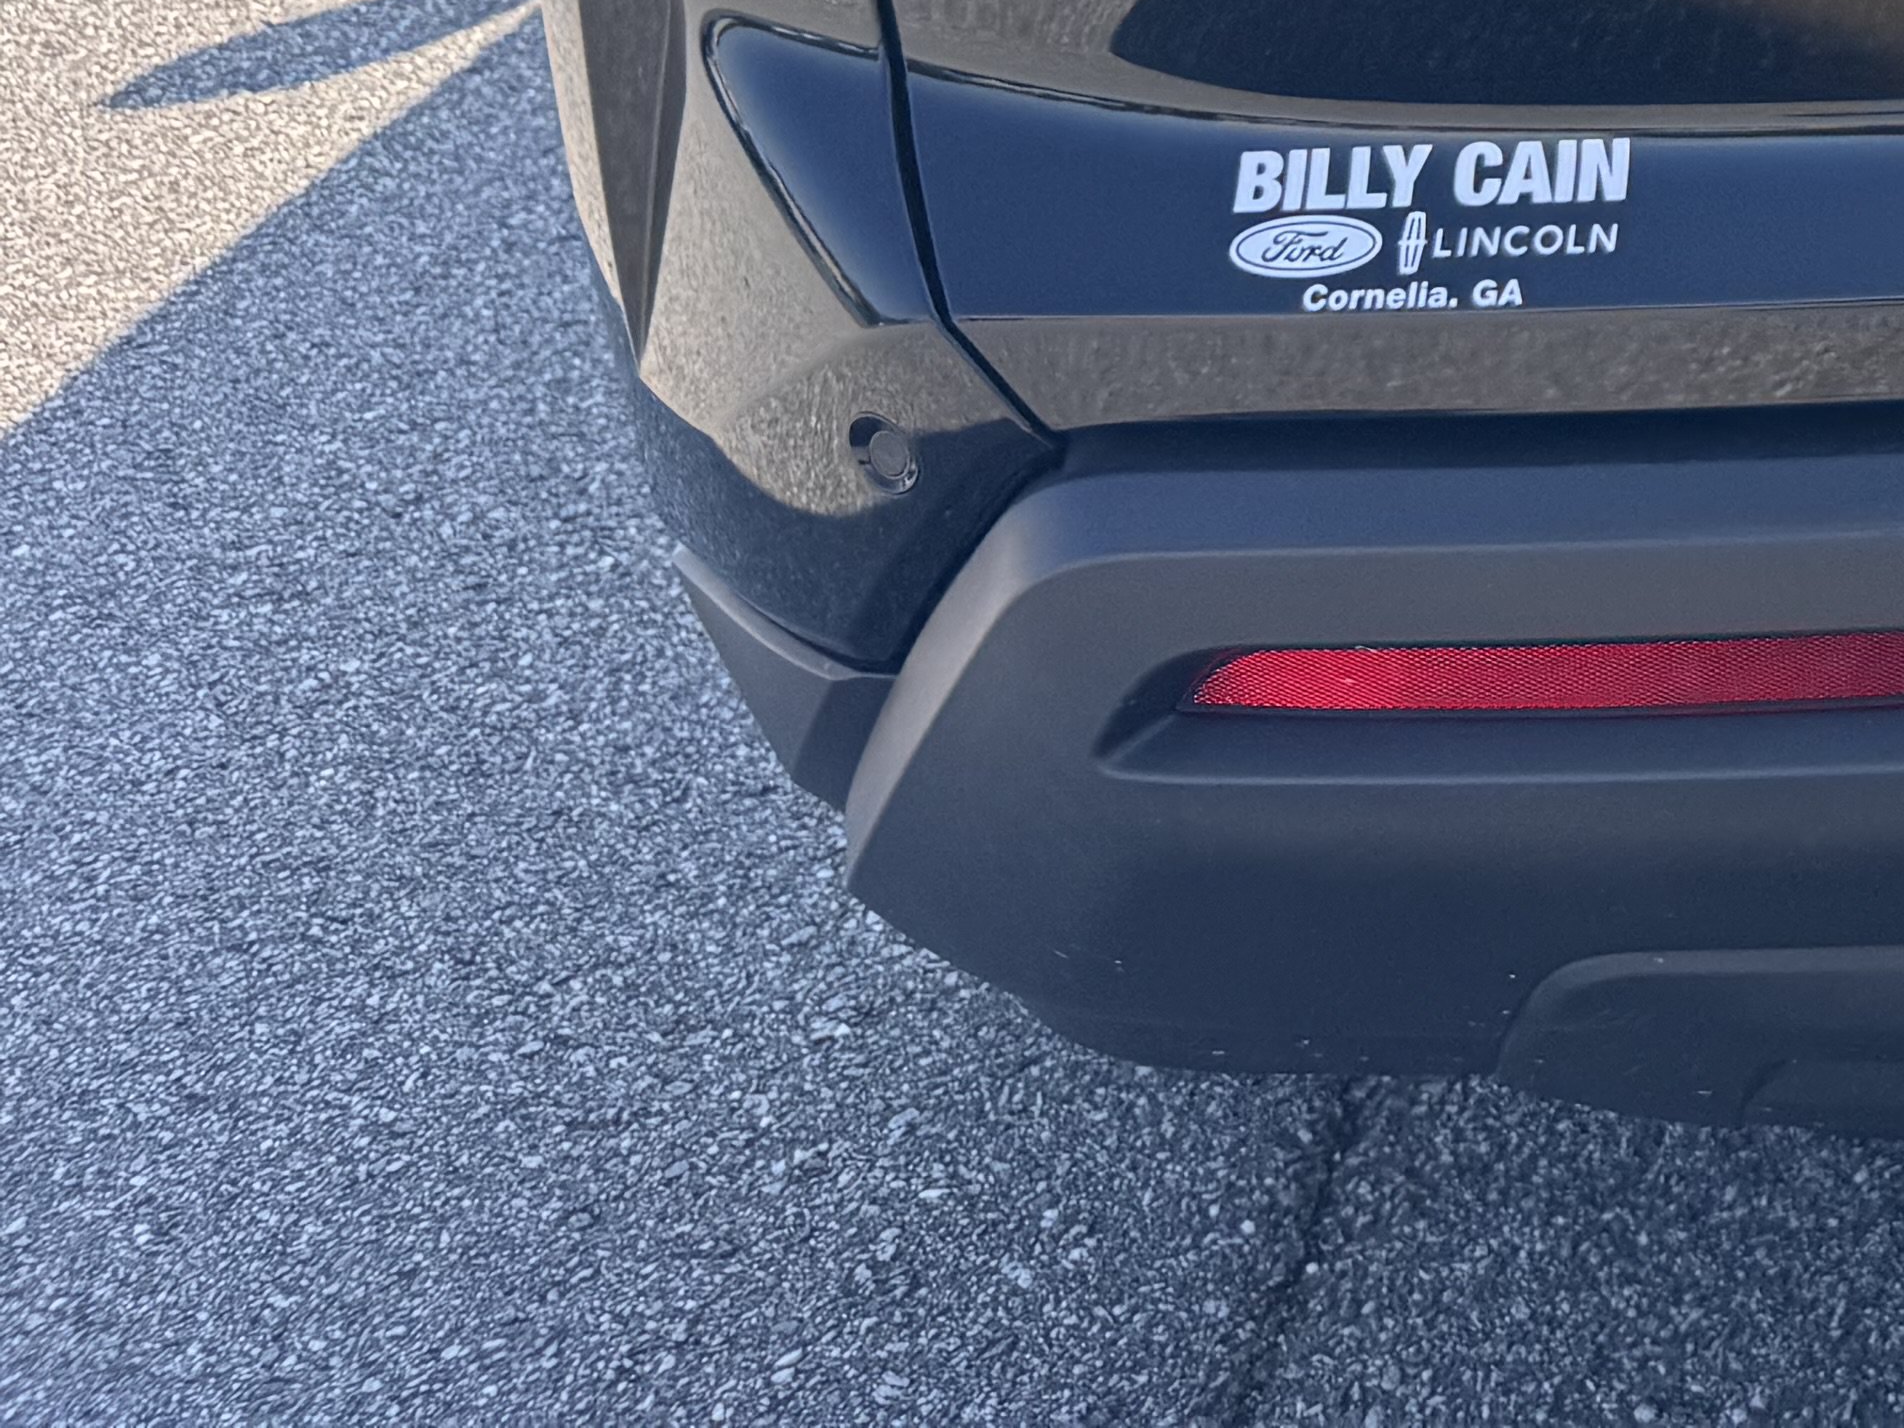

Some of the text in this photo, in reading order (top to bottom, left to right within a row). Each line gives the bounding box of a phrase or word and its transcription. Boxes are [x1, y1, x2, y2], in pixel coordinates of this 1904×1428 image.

[1232, 137, 1631, 214] BILLY CAIN
[1260, 223, 1619, 263] Ford LINCOLN
[1471, 278, 1524, 308] GA
